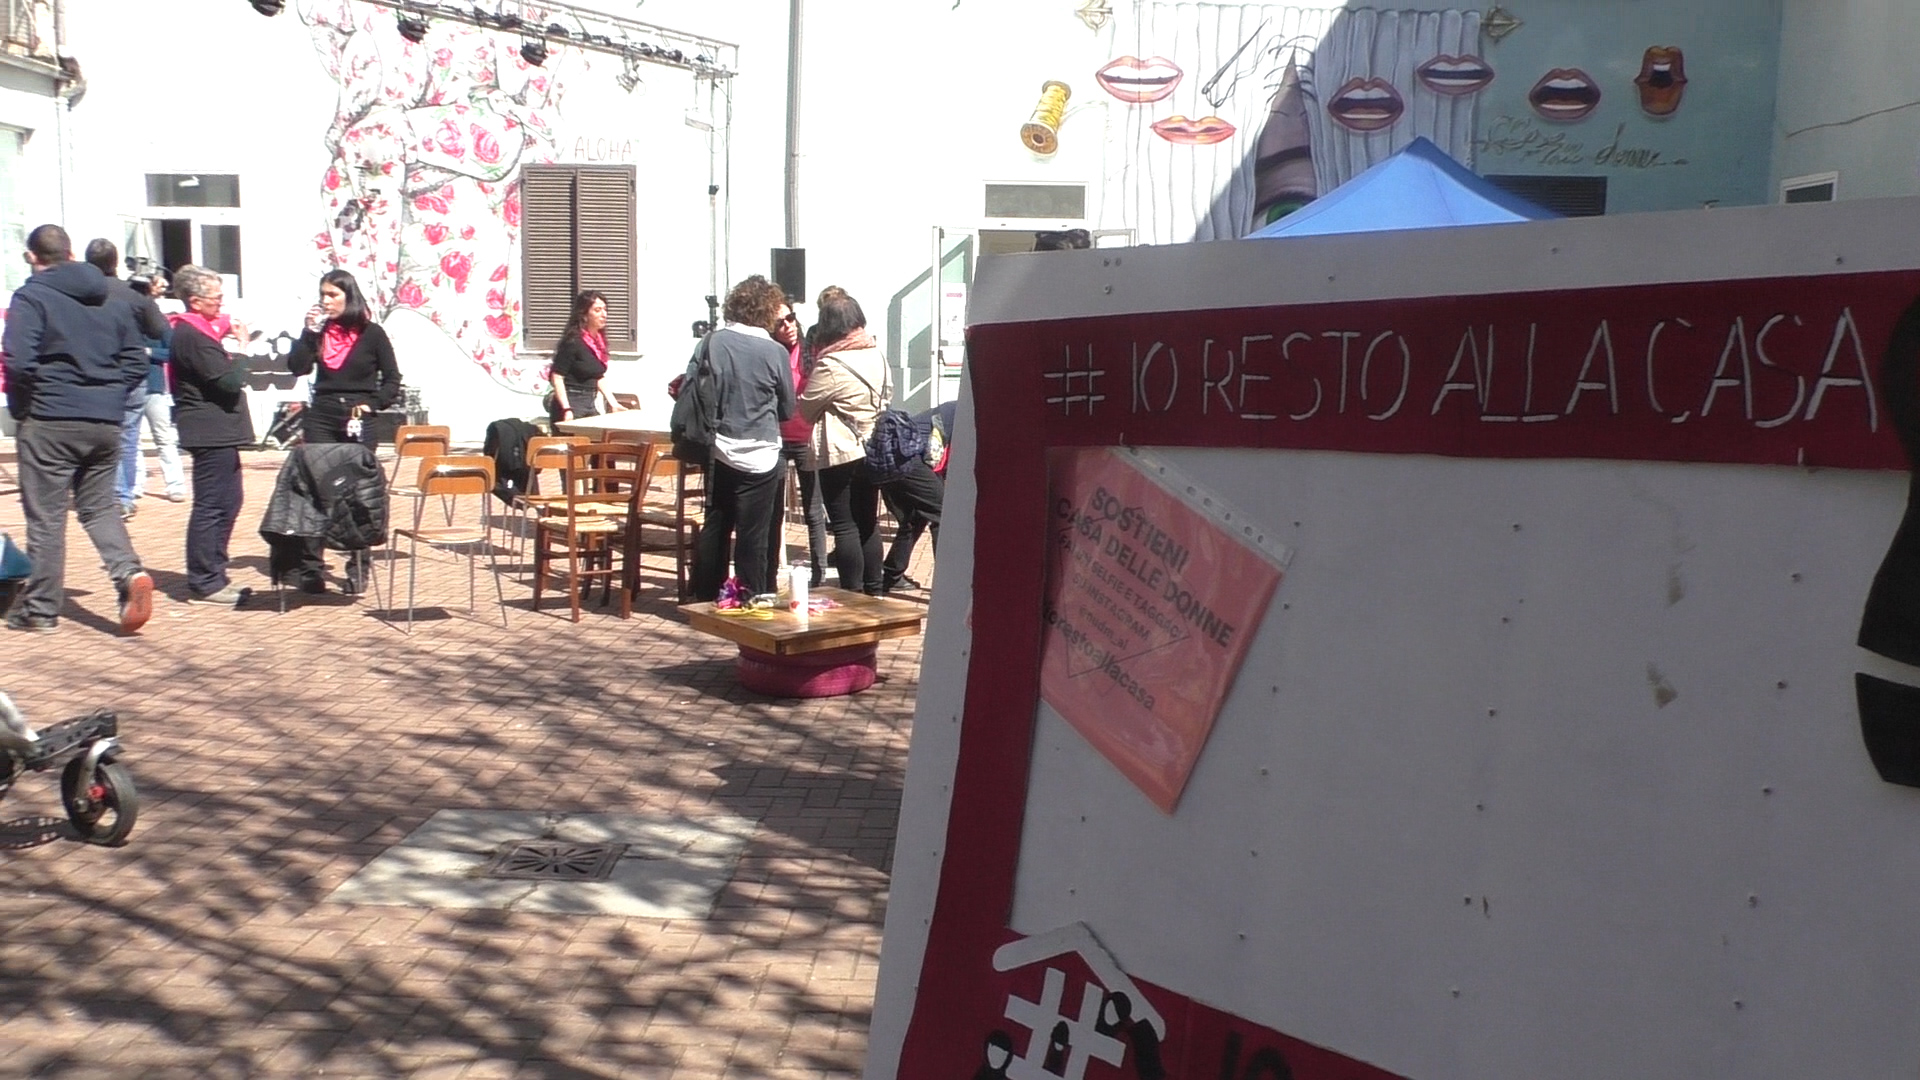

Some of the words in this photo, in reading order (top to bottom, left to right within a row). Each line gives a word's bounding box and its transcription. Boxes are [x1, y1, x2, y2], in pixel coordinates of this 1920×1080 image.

[574, 136, 632, 162] ALOHA
[1131, 340, 1178, 413] IO
[1202, 330, 1411, 421] RESTO
[1431, 319, 1619, 423] ALLA
[1646, 306, 1877, 433] CASA
[1057, 497, 1103, 547] CASA
[1105, 534, 1162, 590] DELLE
[1163, 574, 1236, 649] DONNE
[1092, 487, 1189, 571] SOSTIENI
